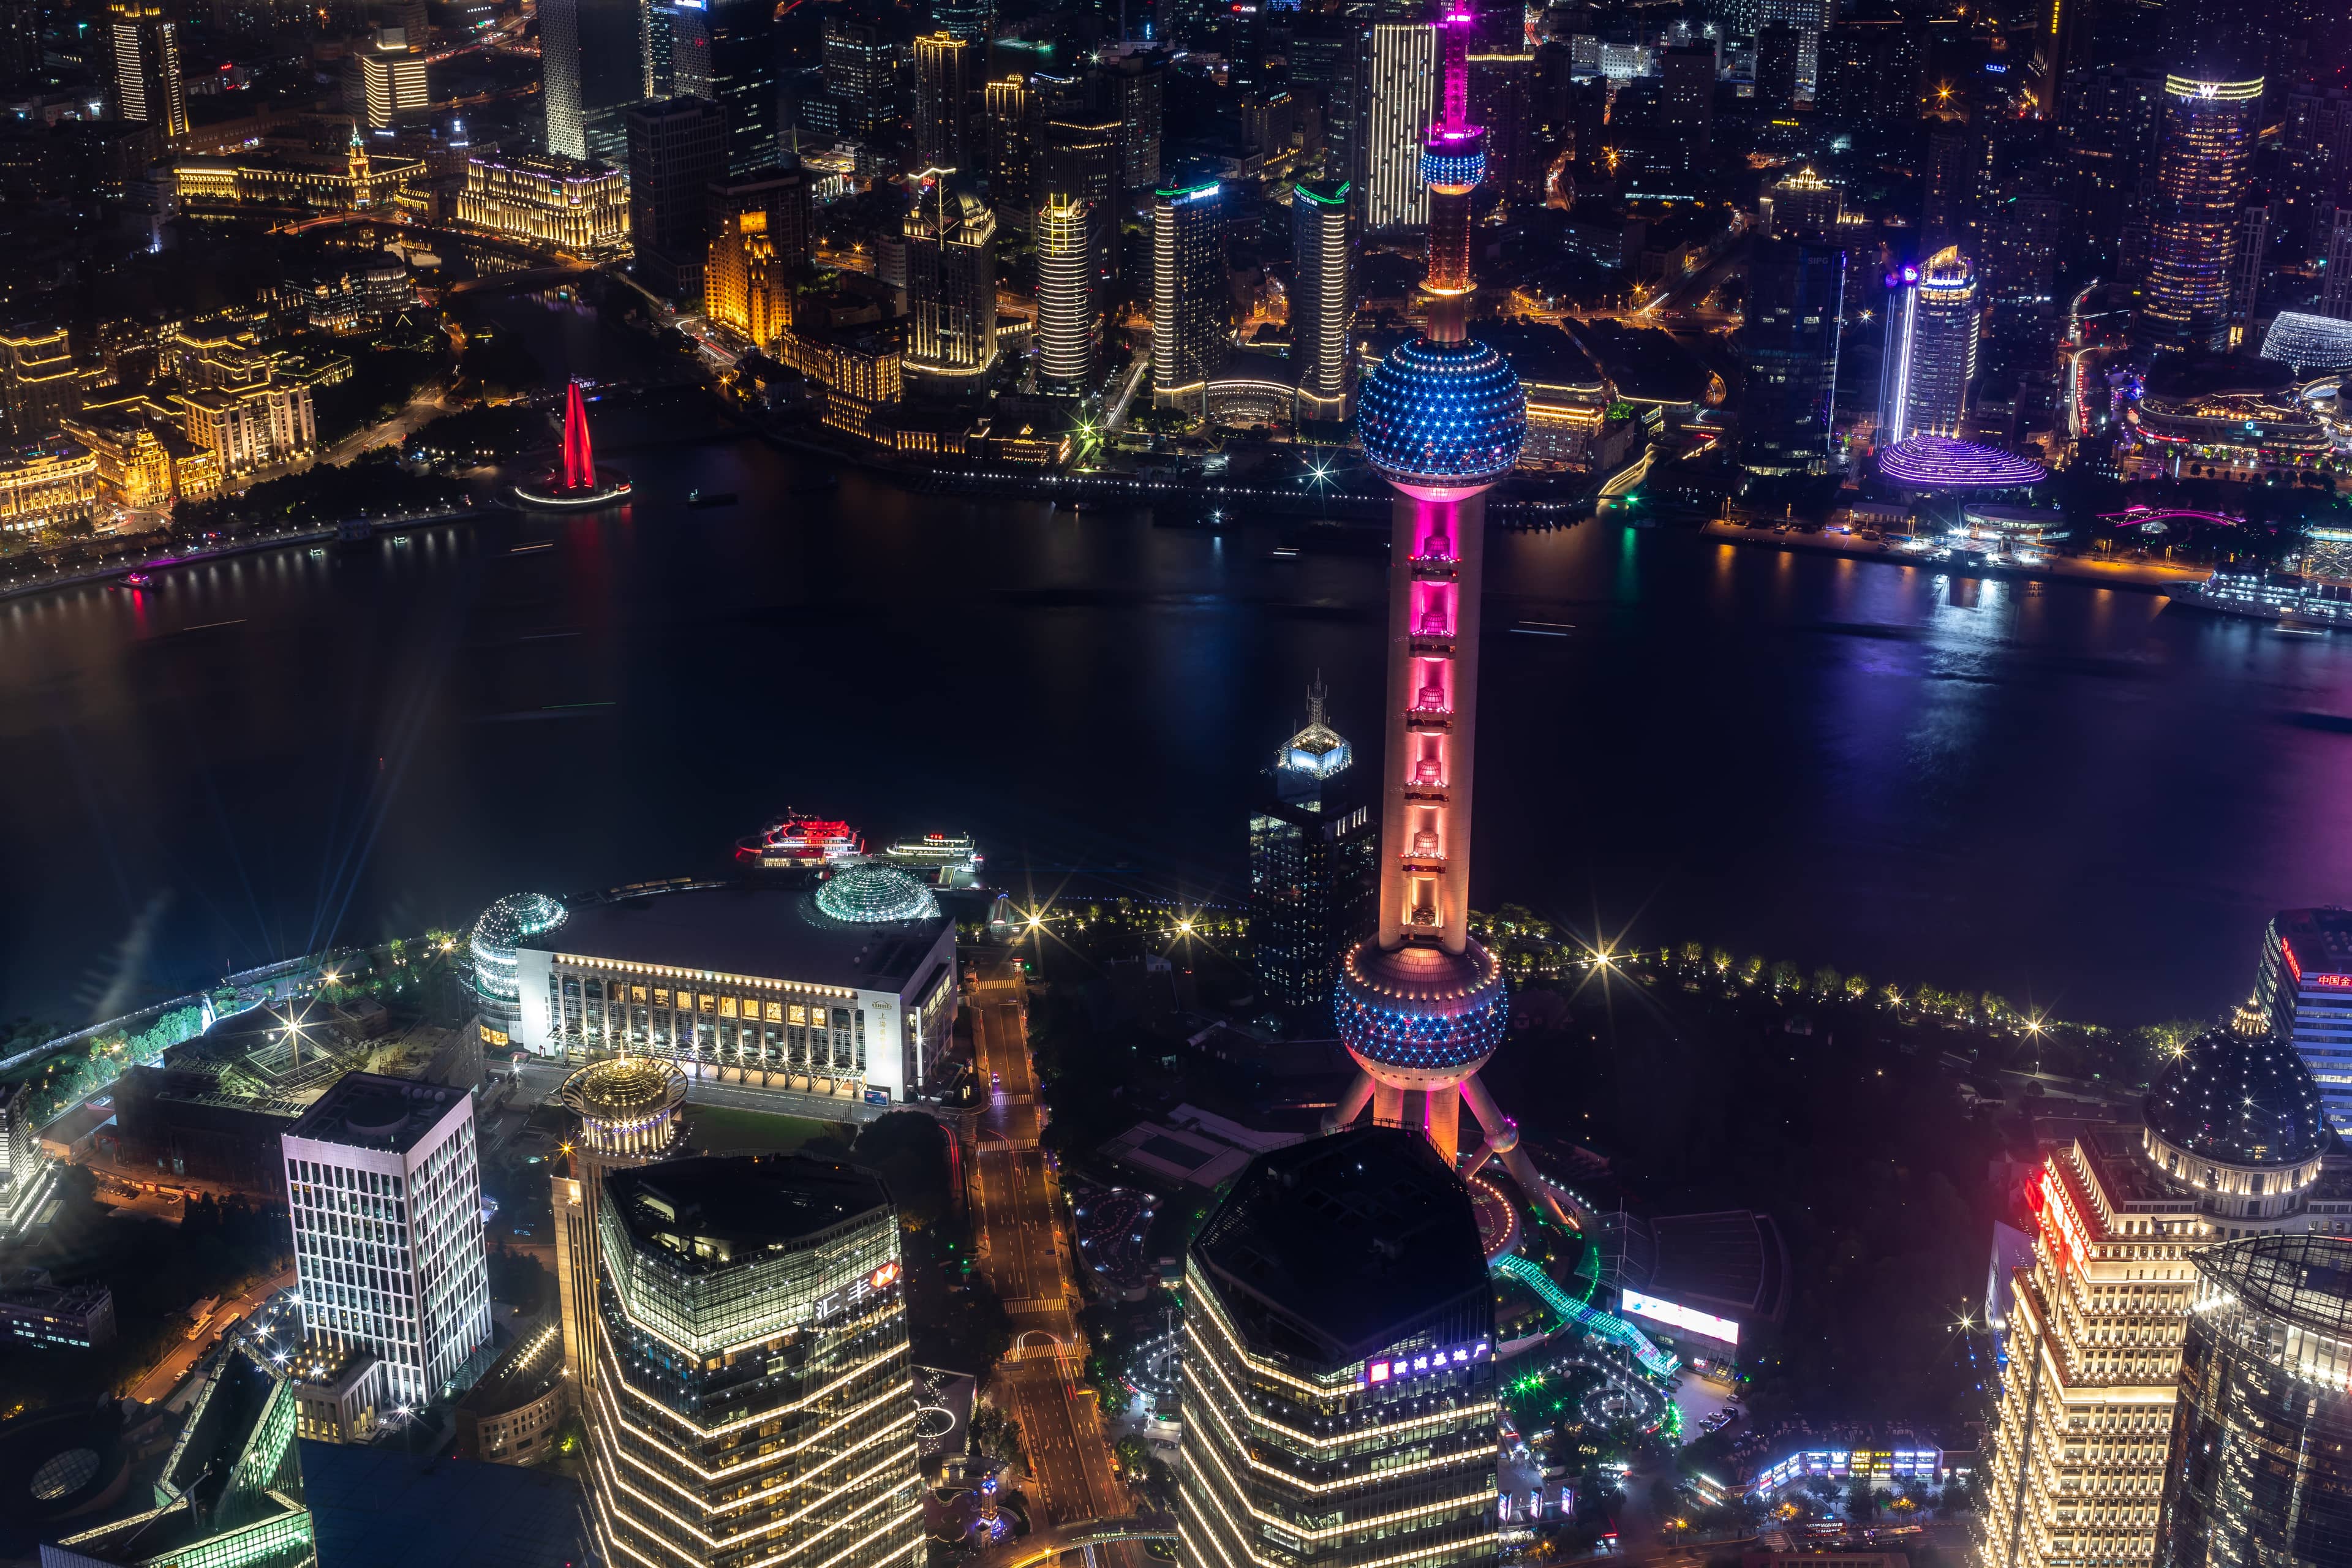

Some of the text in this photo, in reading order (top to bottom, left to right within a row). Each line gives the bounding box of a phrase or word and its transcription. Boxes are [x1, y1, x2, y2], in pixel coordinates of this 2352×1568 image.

[2200, 84, 2218, 100] W
[1306, 197, 1317, 206] BUND
[2318, 975, 2352, 986] 中国金
[815, 1278, 871, 1320] 汇丰
